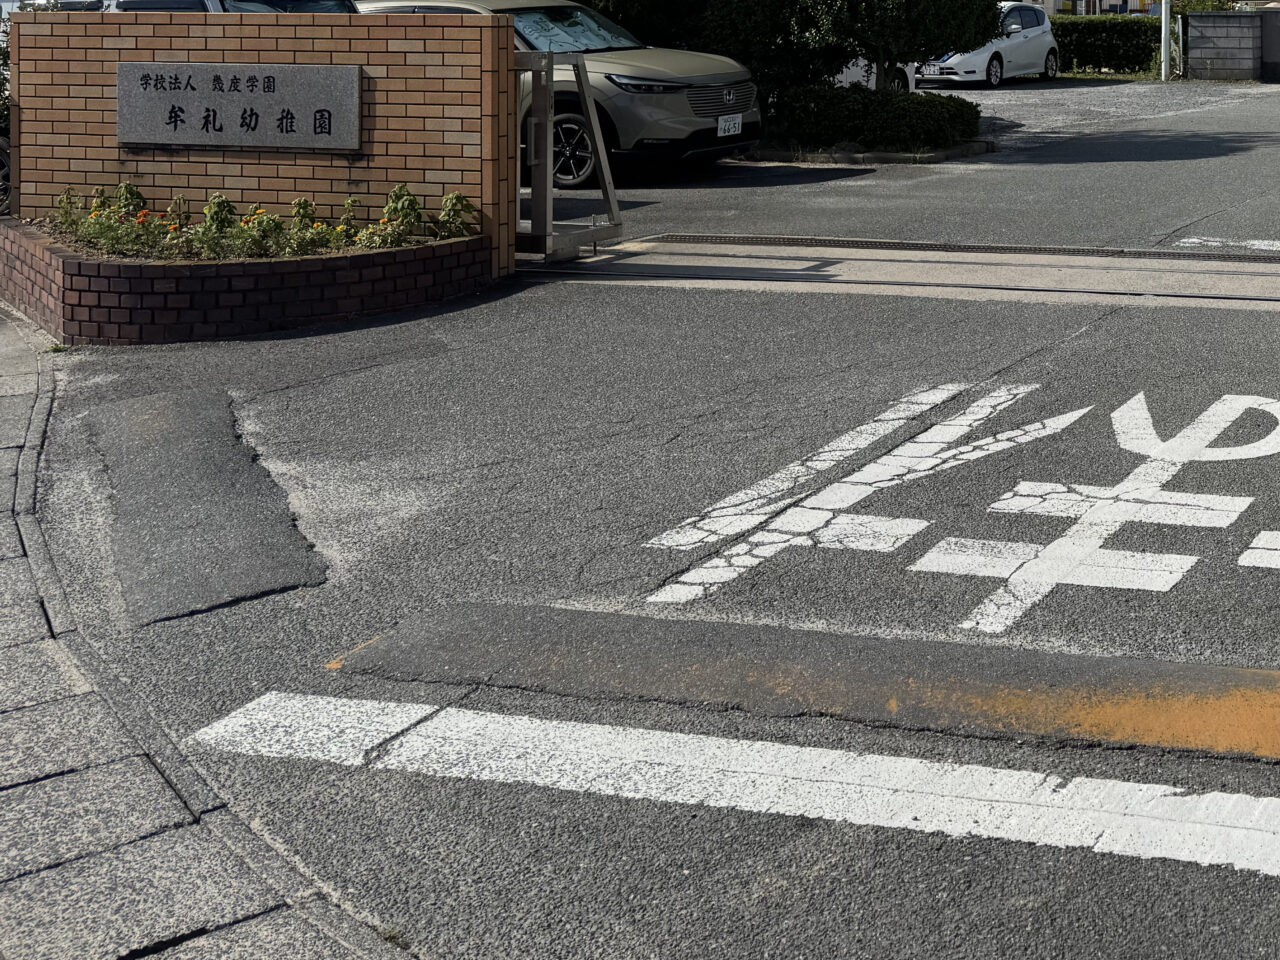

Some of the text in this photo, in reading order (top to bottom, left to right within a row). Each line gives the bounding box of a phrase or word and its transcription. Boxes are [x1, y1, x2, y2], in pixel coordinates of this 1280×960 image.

[139, 73, 197, 91] 学校法人
[165, 104, 332, 136] 牟礼幼稚園
